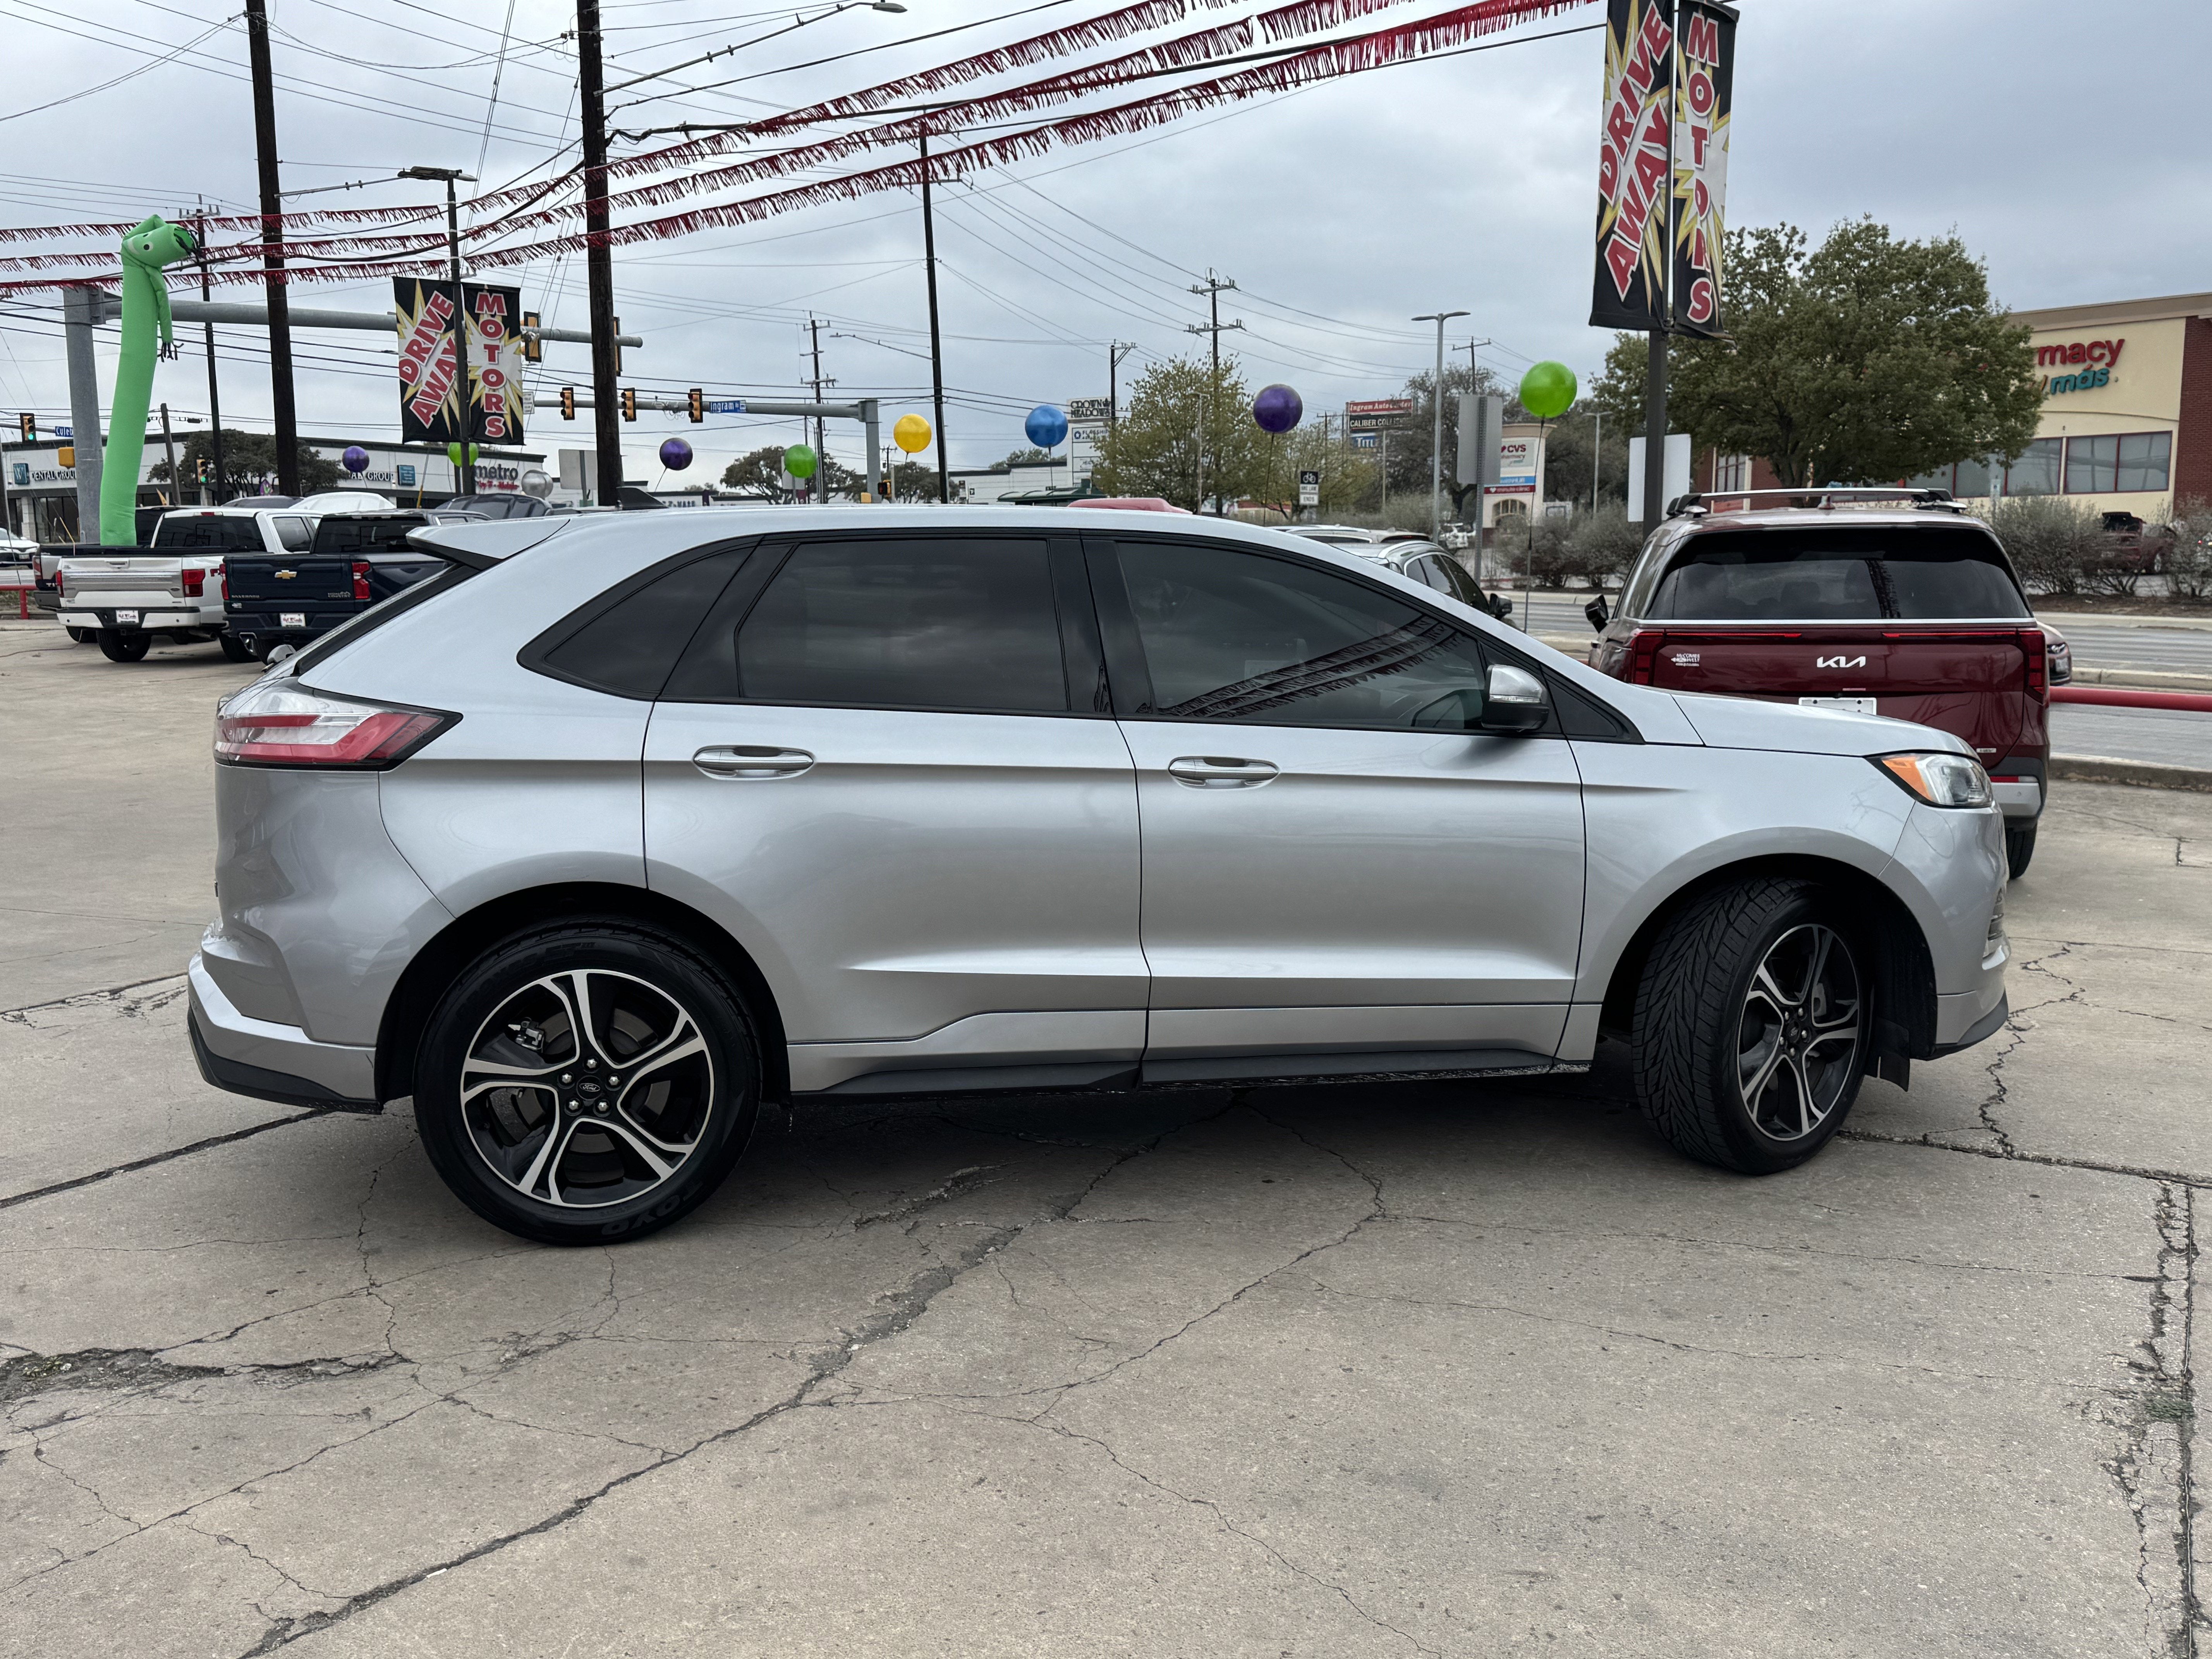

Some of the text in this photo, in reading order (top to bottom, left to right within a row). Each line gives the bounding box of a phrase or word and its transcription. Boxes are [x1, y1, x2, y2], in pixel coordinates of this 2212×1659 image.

[1600, 0, 1672, 206] DRIVE
[1604, 94, 1668, 302] AWAY
[399, 290, 454, 386] DRIVE
[475, 292, 508, 438] MOTORS
[2038, 339, 2125, 368] macy
[410, 335, 457, 429] AWAY
[2050, 364, 2110, 395] más
[710, 402, 734, 412] Ingram
[1071, 400, 1102, 409] CROWN
[32, 471, 57, 481] DENTAL
[367, 472, 394, 482] GROUP
[475, 464, 518, 481] metro
[1817, 656, 1866, 668] KIA
